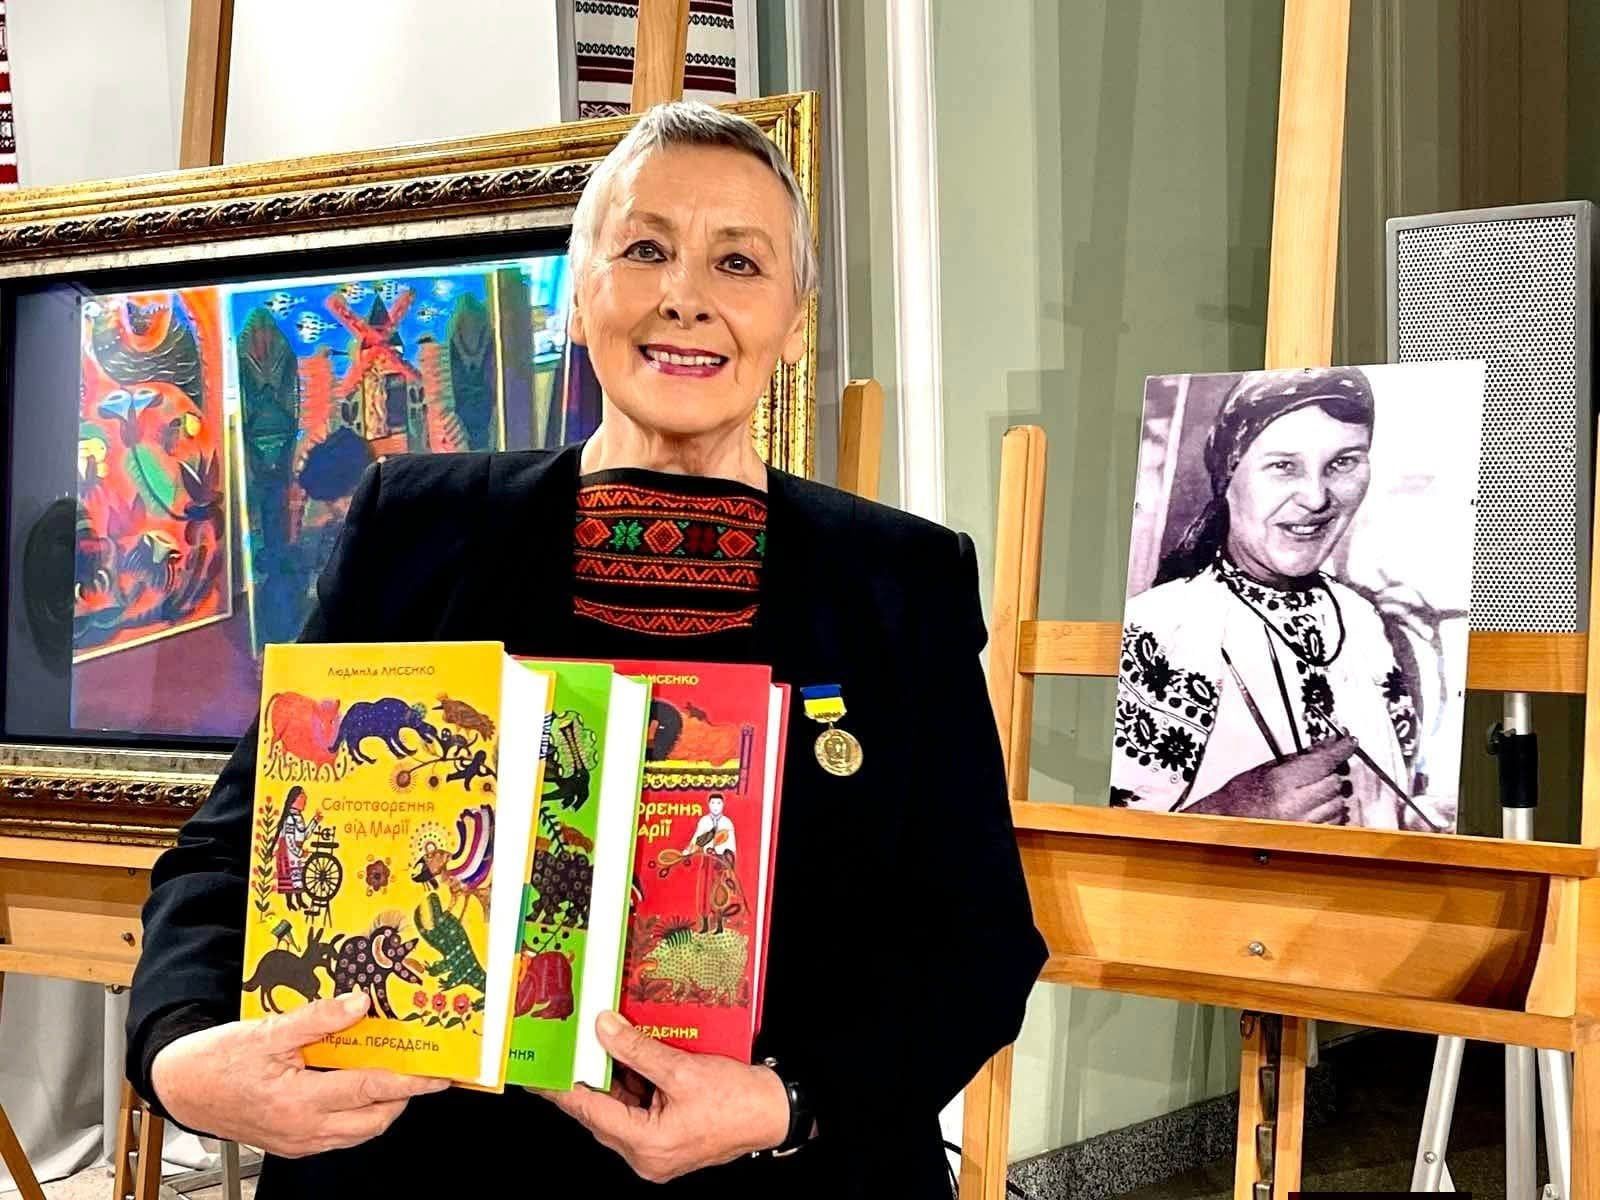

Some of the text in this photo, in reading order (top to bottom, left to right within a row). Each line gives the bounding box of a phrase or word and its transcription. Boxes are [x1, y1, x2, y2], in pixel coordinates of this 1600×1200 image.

[641, 674, 700, 686] ИСЕНКО
[321, 796, 435, 818] Світотворення
[638, 802, 702, 822] орення
[344, 819, 410, 840] від Марії
[638, 818, 673, 844] арії
[634, 1025, 699, 1040] ЕДЕННЯ
[509, 1048, 535, 1061] ННЯ
